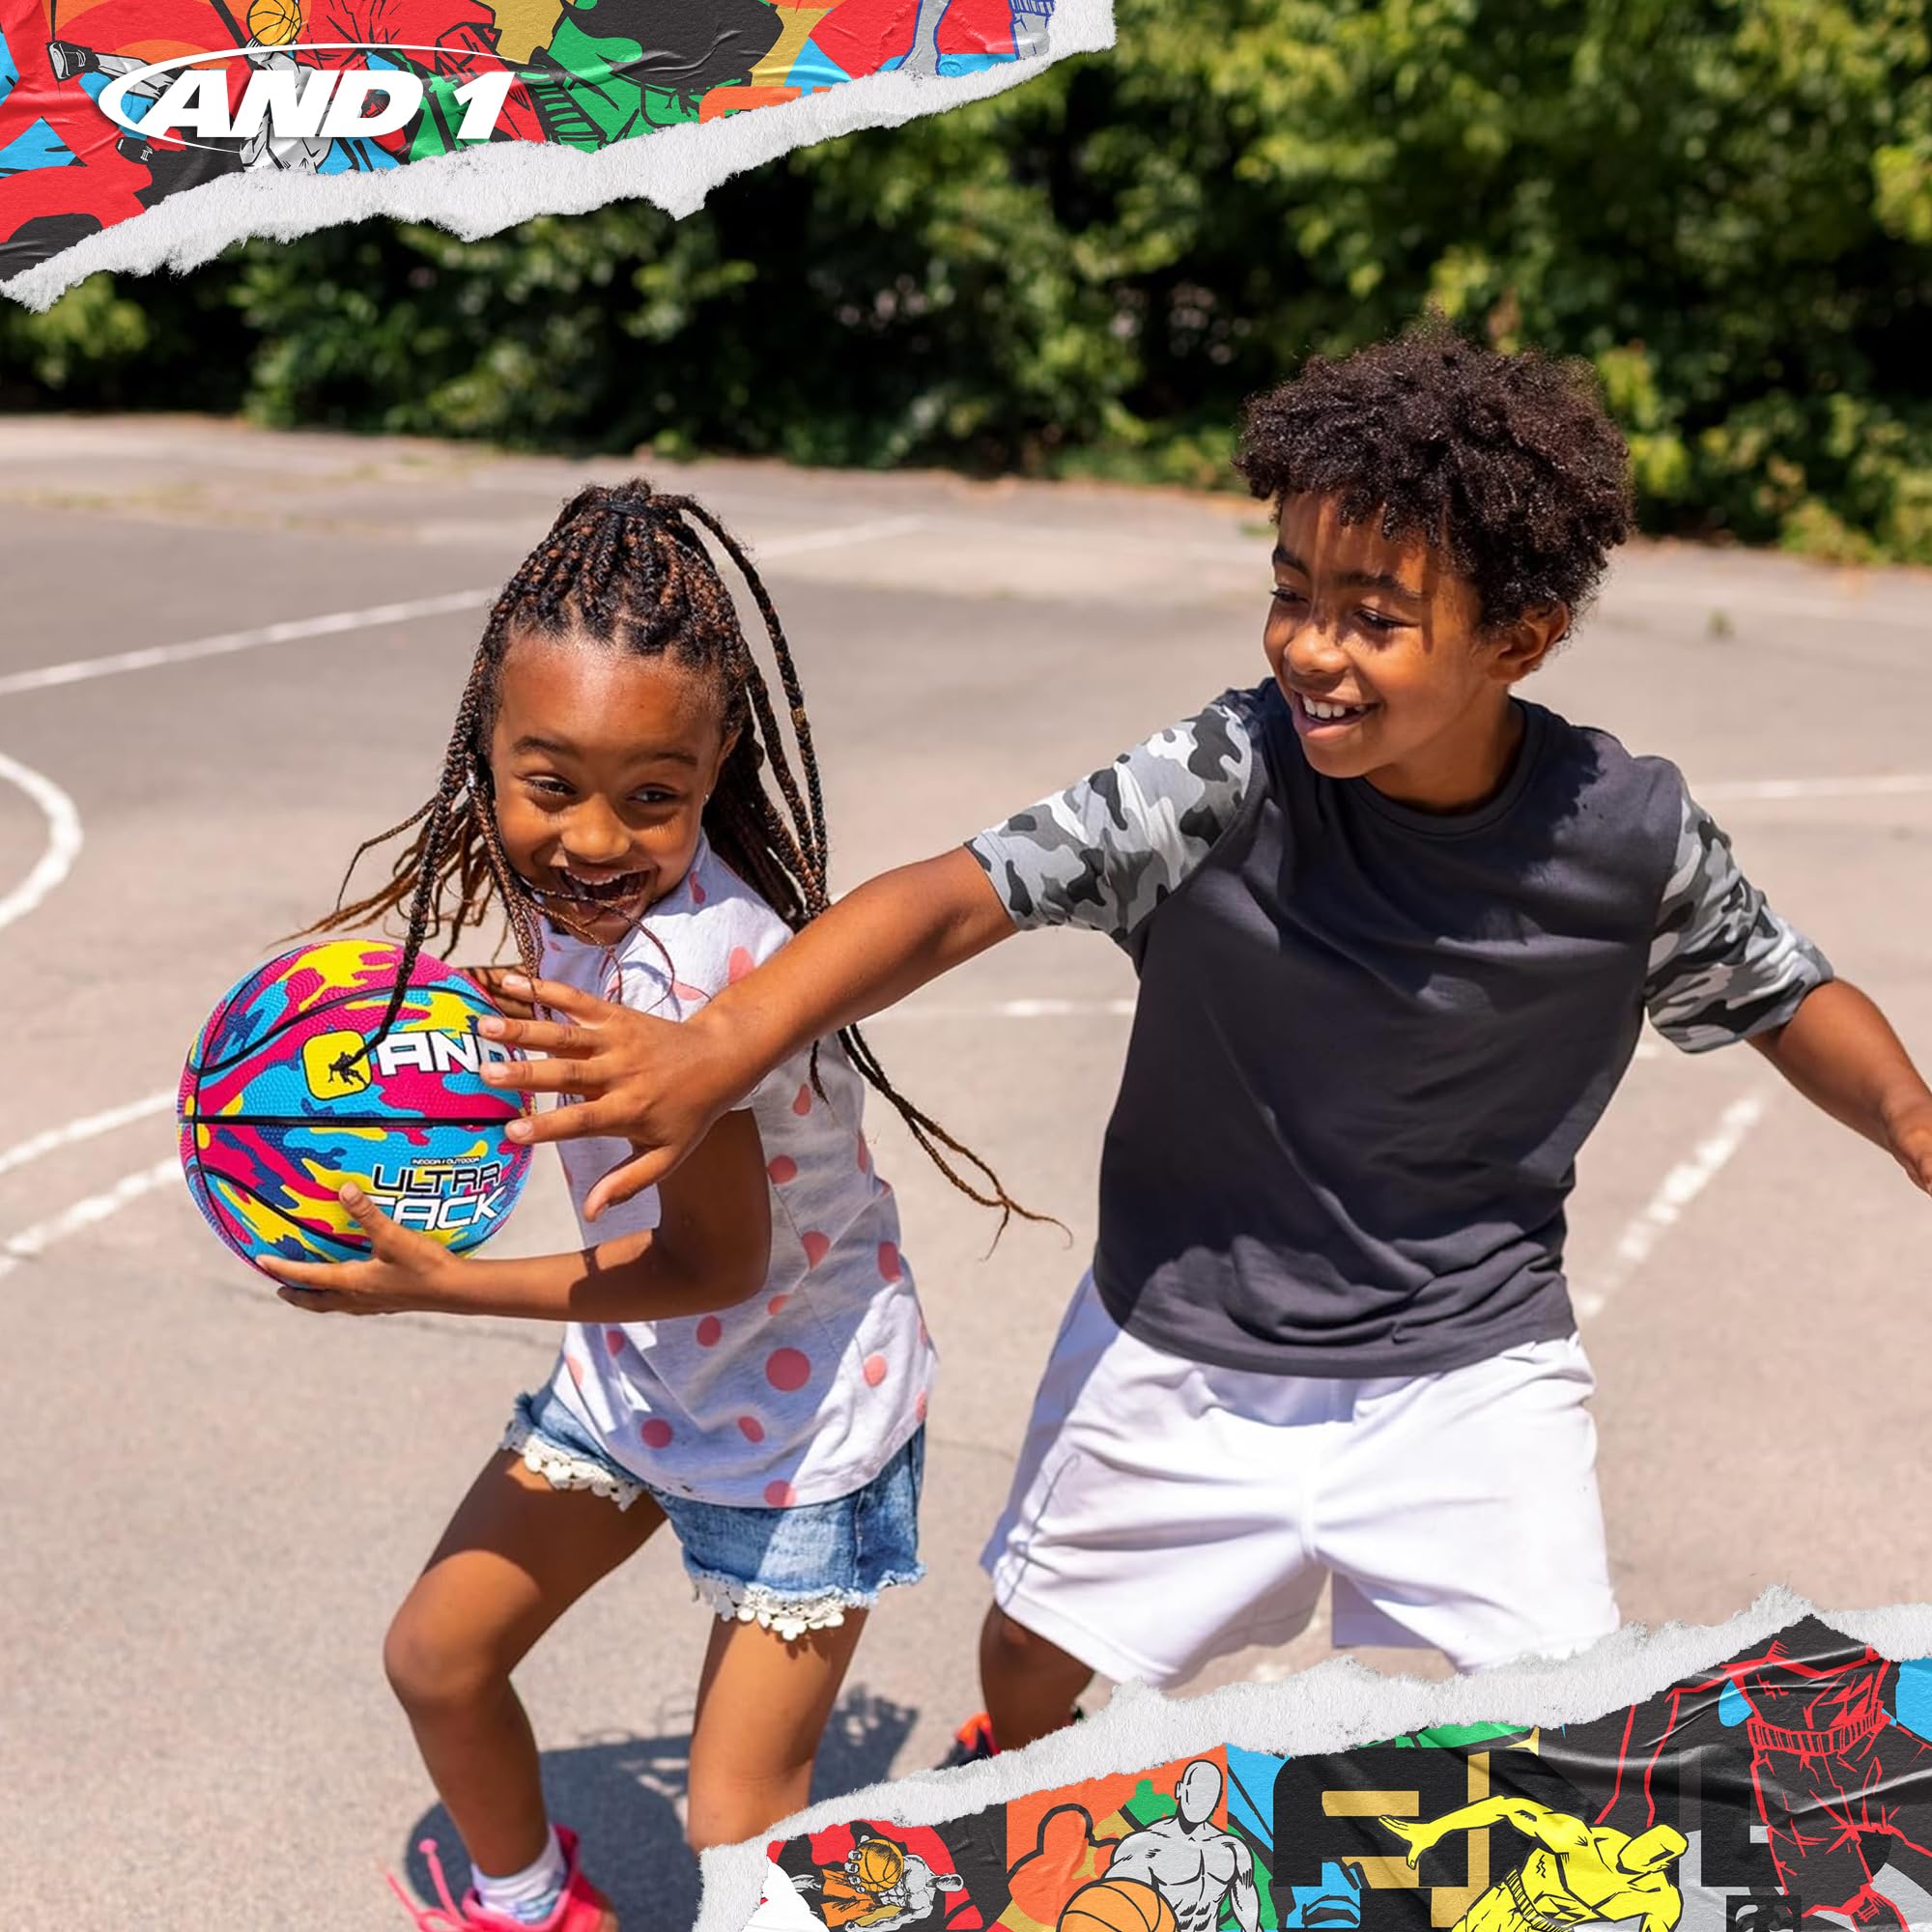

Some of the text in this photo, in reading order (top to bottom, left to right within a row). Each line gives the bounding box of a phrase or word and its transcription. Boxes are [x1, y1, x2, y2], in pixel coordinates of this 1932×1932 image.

[412, 1157, 441, 1166] INDOOR
[446, 1156, 480, 1165] OUTDOOR
[372, 1161, 501, 1195] ULTRA
